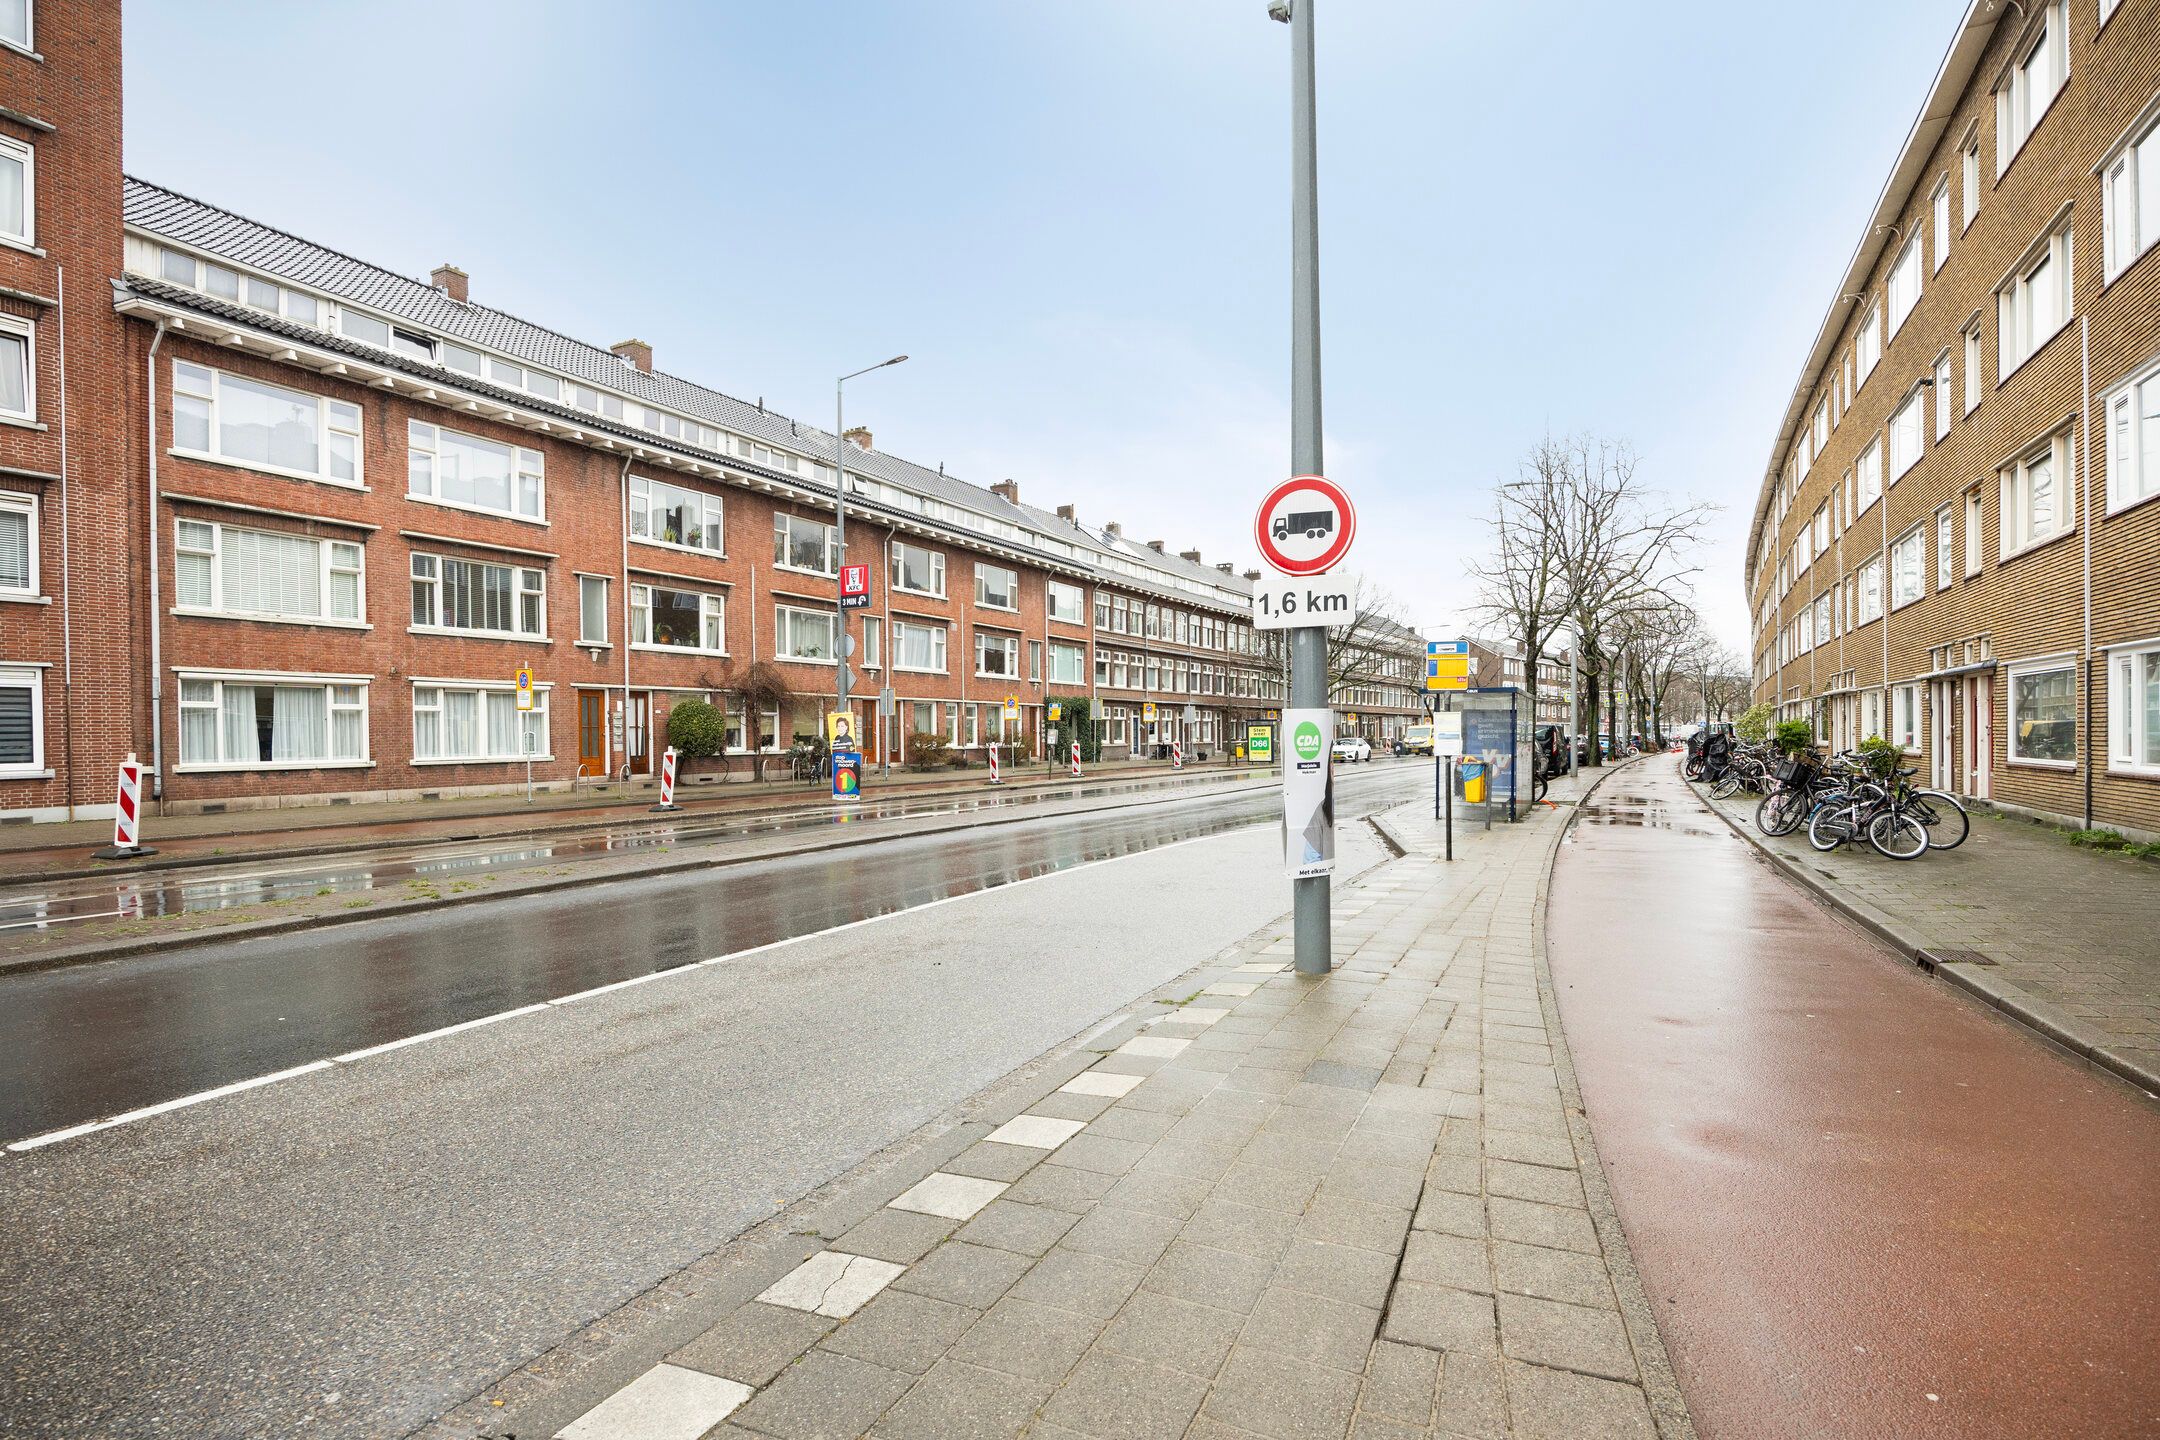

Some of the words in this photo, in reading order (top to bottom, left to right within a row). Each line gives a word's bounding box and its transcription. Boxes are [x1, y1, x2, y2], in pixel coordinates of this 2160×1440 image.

[842, 598, 847, 606] 3
[847, 597, 857, 605] MIN
[1259, 591, 1297, 619] 1,6
[1307, 590, 1348, 612] km
[1252, 740, 1268, 748] D66
[1296, 734, 1319, 747] CDA
[839, 771, 848, 790] 1
